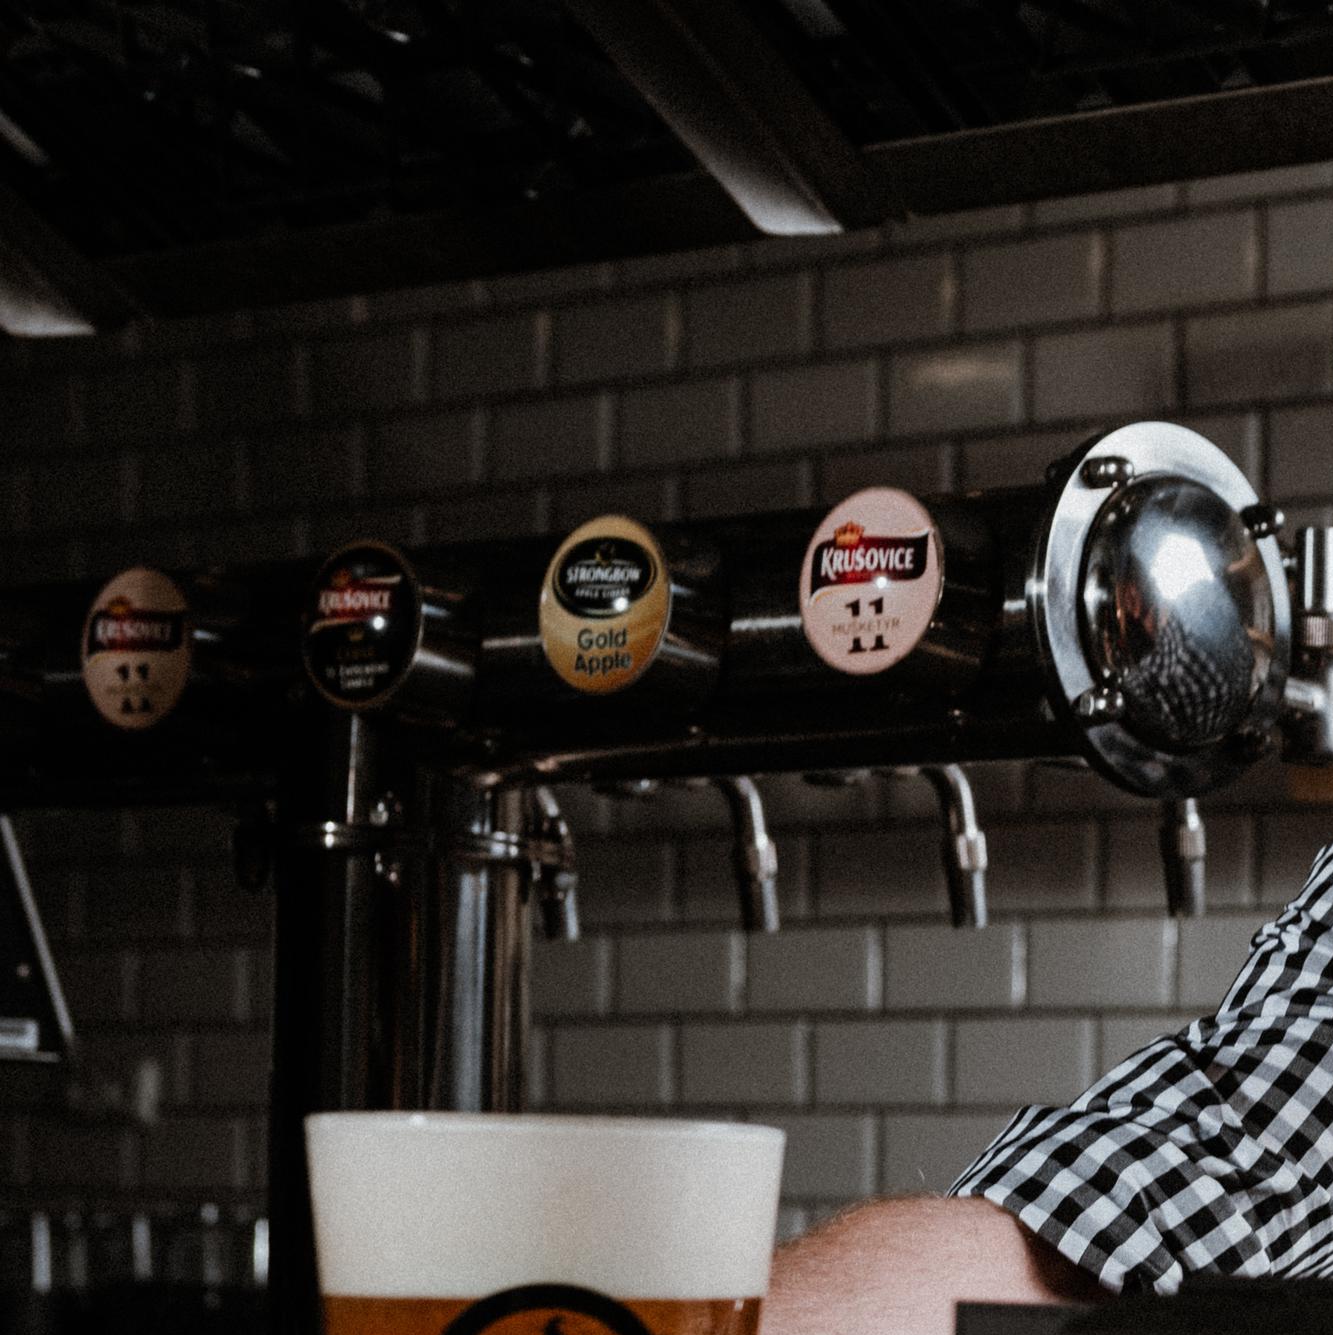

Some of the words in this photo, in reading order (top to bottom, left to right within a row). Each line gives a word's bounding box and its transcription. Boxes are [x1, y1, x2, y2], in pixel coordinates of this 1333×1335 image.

[820, 544, 915, 580] KRUŠOVICE
[566, 566, 641, 584] STRONGBOW
[577, 627, 627, 650] Gold
[574, 652, 631, 676] Apple
